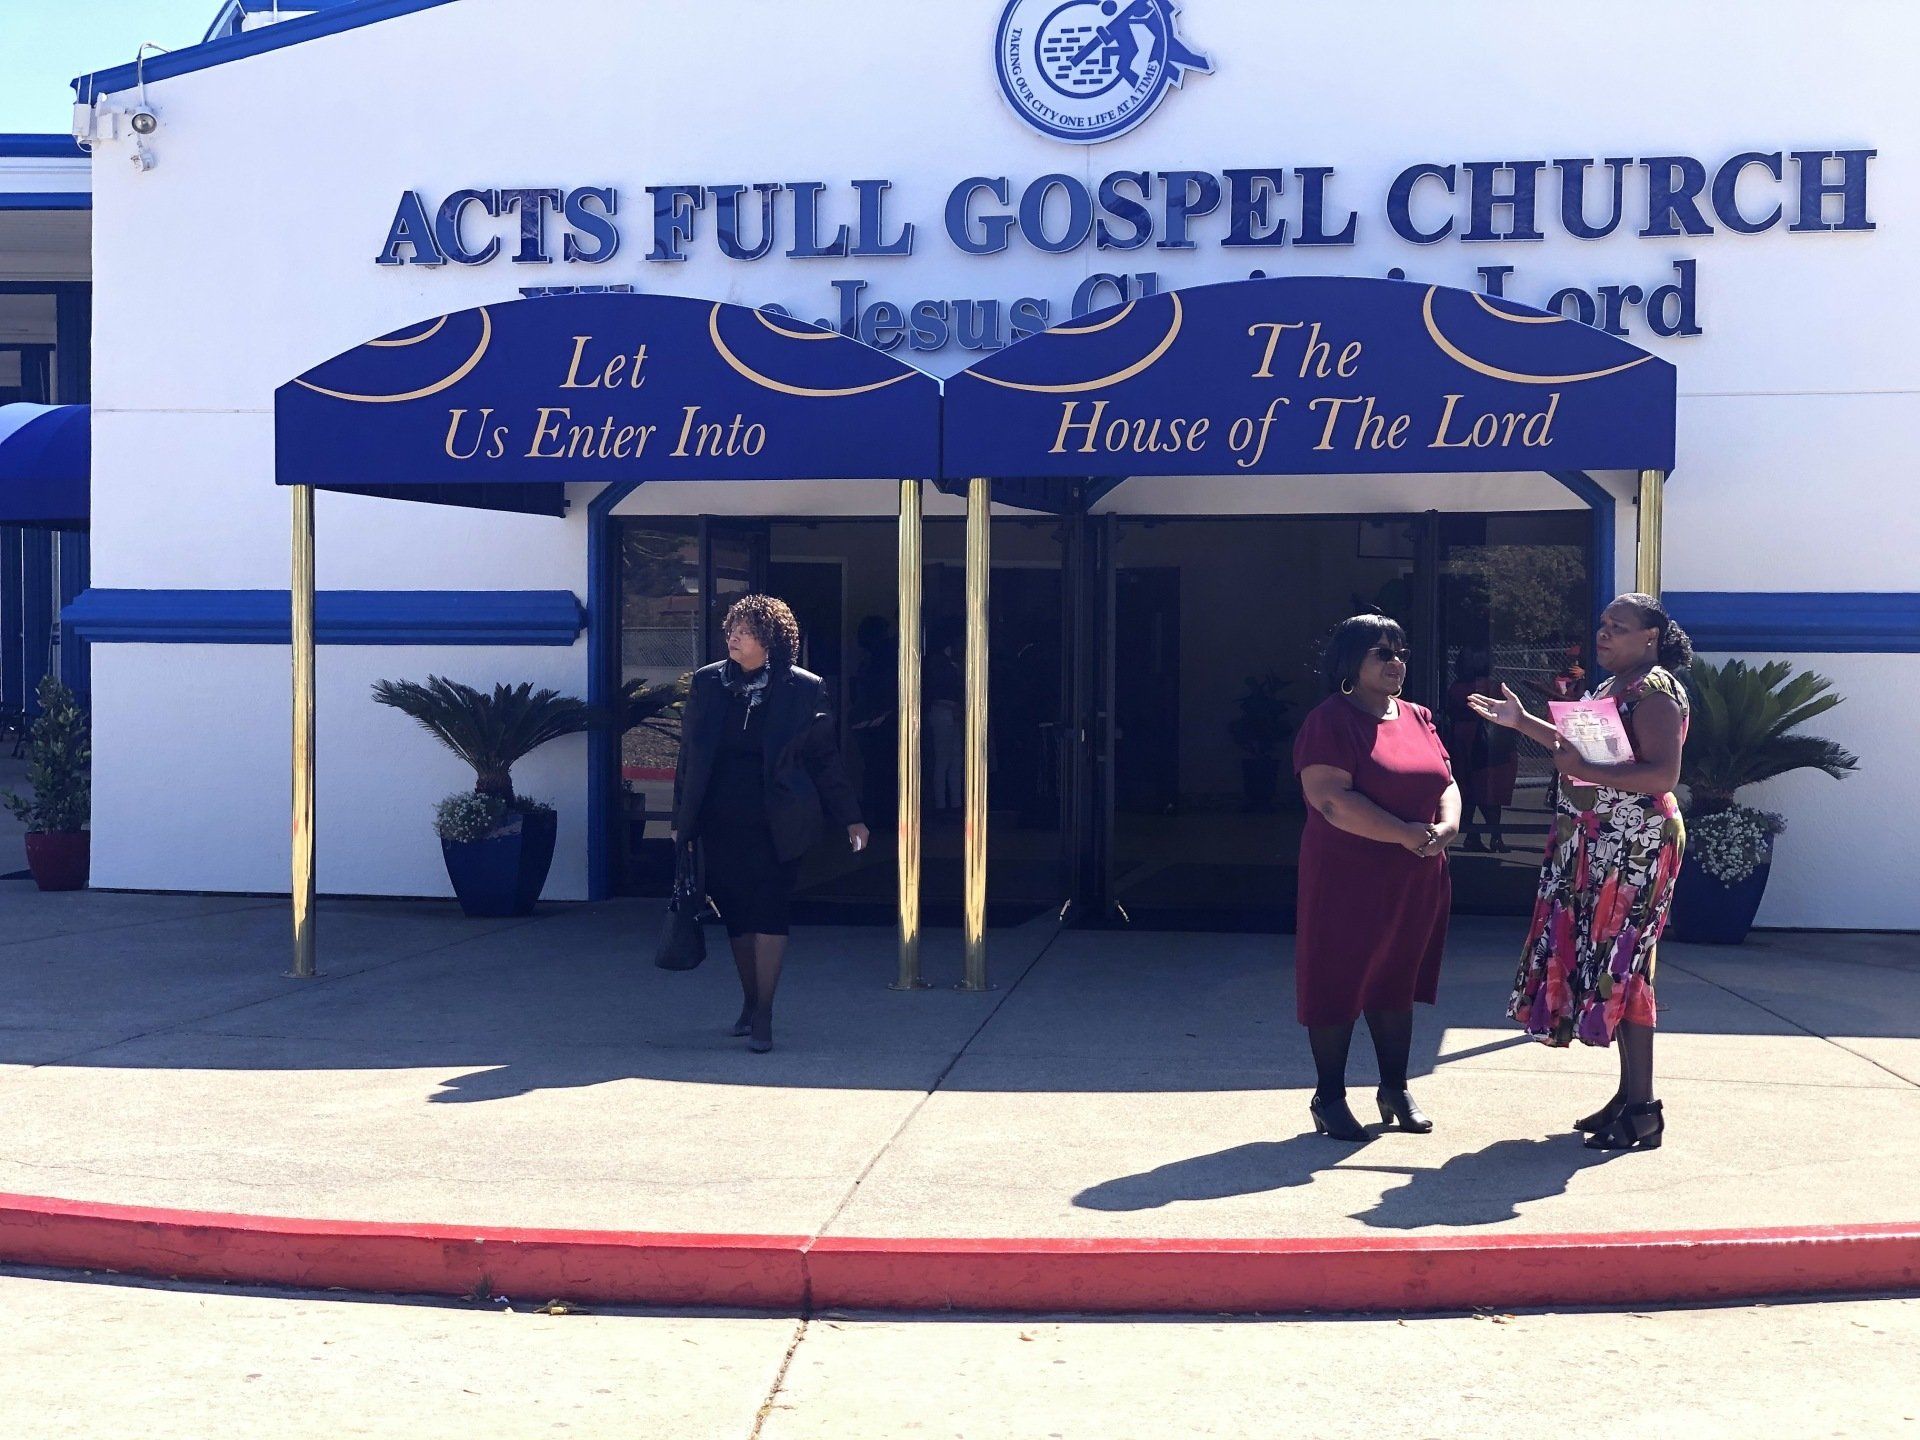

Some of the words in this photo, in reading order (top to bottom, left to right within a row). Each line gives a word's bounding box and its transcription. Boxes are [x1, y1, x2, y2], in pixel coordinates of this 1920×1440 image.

[1010, 27, 1023, 76] TAKING
[1015, 73, 1035, 103] OUR
[1130, 94, 1141, 105] A
[1135, 62, 1158, 96] TIME
[1032, 99, 1061, 120] CITY
[1059, 114, 1085, 127] ONE
[1088, 109, 1117, 127] LIFE
[1117, 100, 1133, 116] AT
[375, 186, 618, 265] ACTS
[644, 179, 914, 262] FULL
[944, 165, 1358, 255] GOSPEL
[1385, 148, 1879, 242] CHURCH
[828, 279, 1048, 351] Jesus
[559, 335, 648, 389] Let
[1248, 321, 1363, 378] The
[444, 408, 509, 459] Us
[523, 407, 657, 459] Enter
[669, 405, 767, 457] Into
[1047, 400, 1210, 454] House
[1228, 397, 1290, 468] of
[1308, 396, 1411, 450] The
[1427, 393, 1560, 449] Lord
